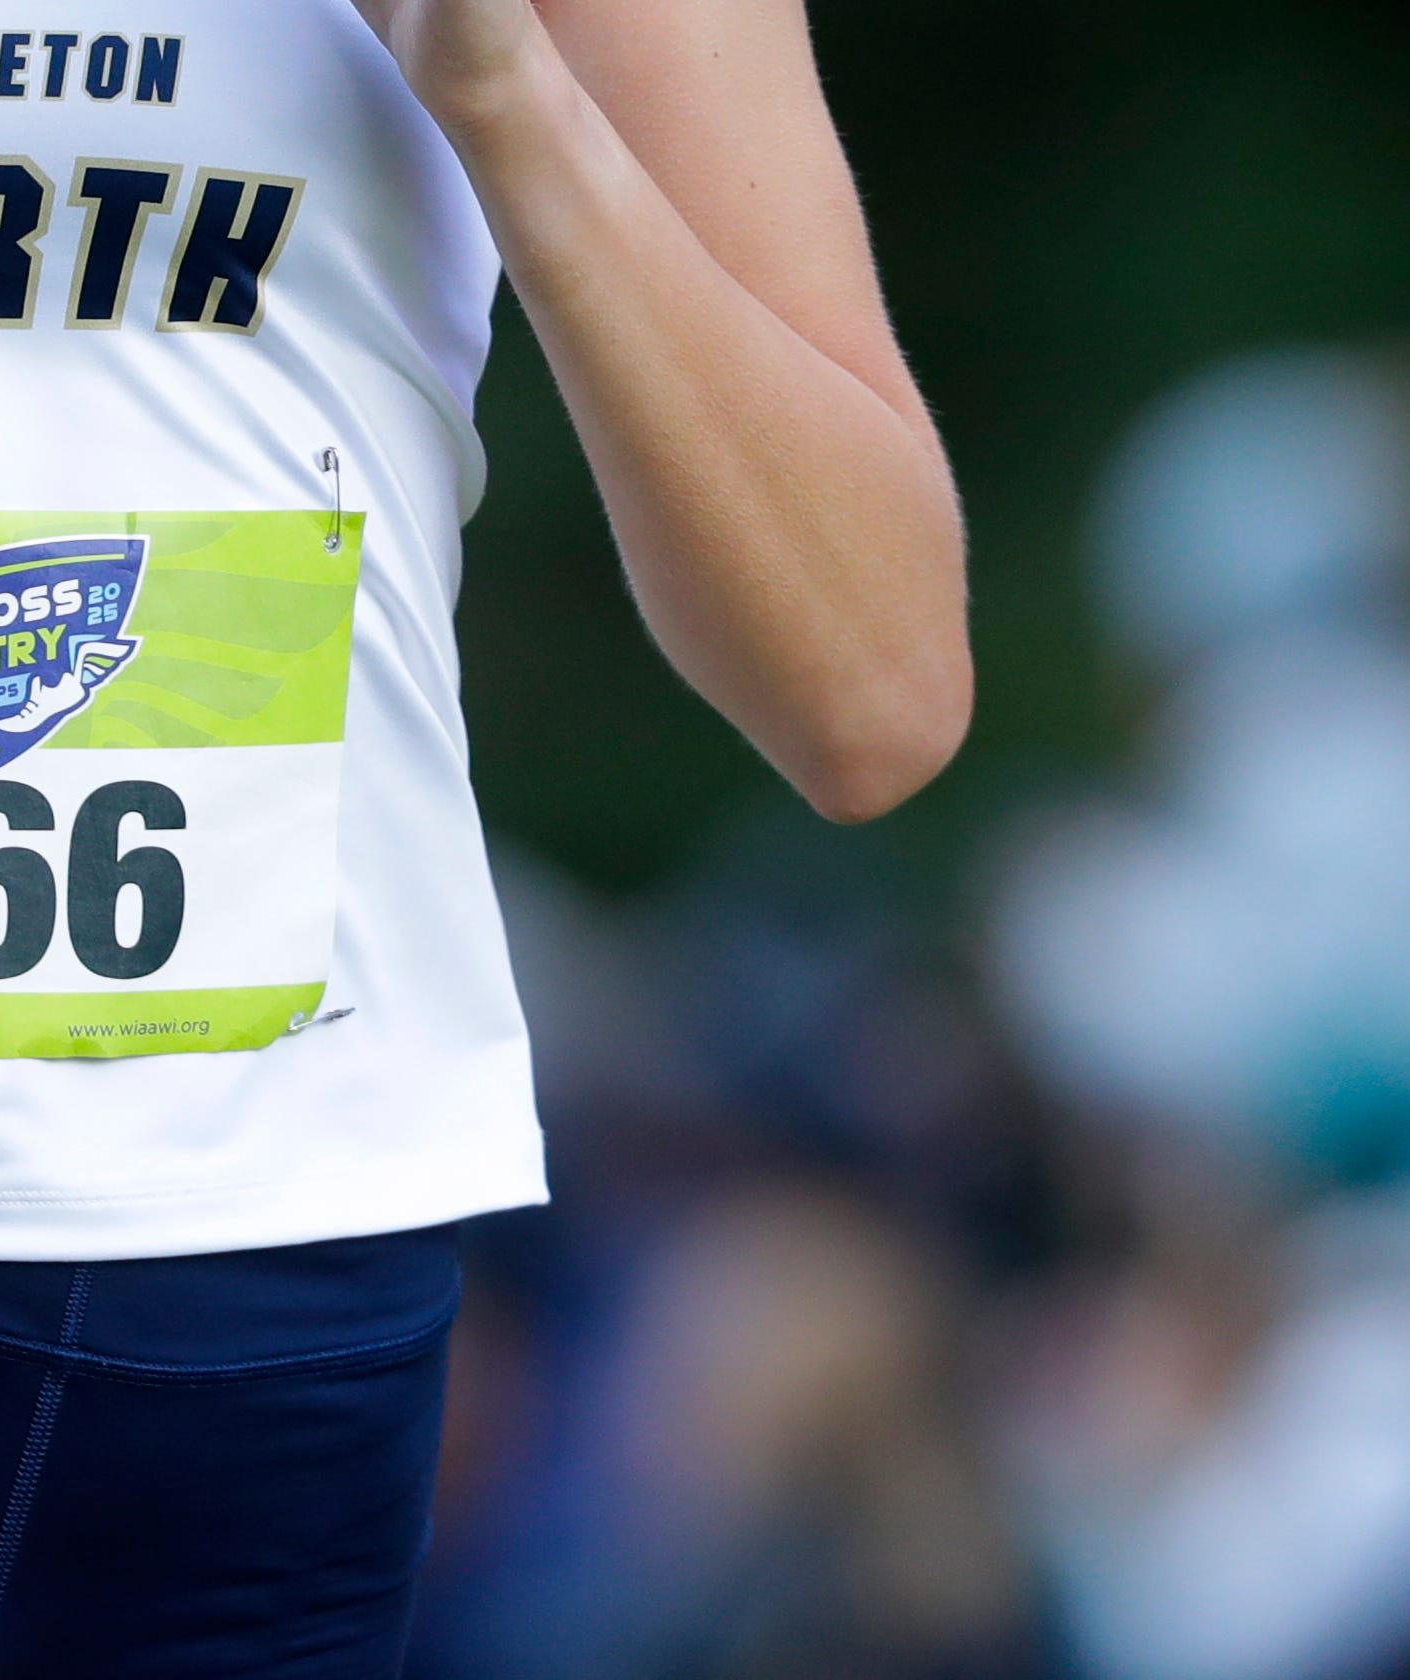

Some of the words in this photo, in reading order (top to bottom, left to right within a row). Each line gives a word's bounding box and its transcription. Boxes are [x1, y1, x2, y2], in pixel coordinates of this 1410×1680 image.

[88, 582, 121, 602] 20
[86, 602, 119, 626] 25
[67, 1018, 210, 1038] www.wiaawi.org
